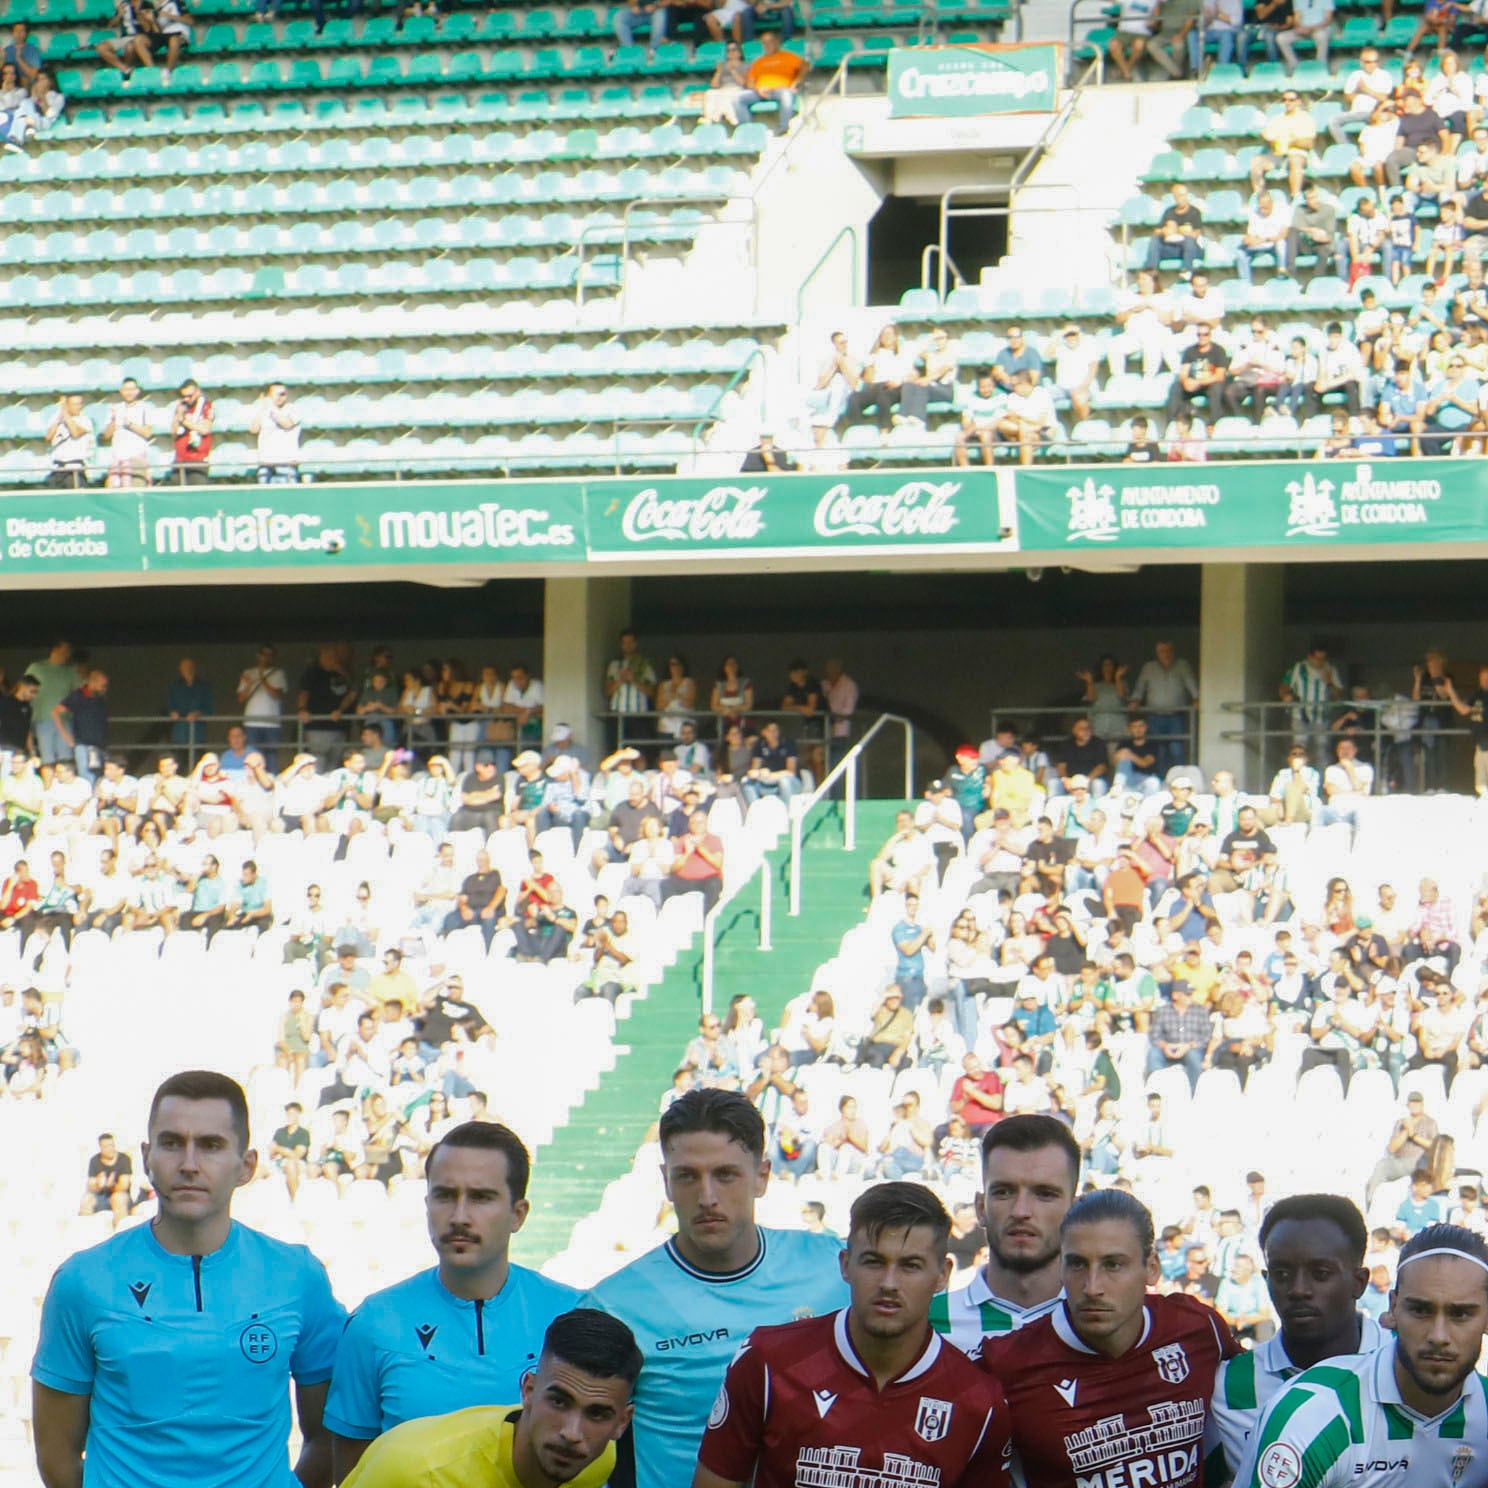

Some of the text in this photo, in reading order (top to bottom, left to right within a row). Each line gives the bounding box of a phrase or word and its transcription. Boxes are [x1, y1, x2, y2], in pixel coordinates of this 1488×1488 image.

[1121, 485, 1219, 506] AYUNTAMIENTO
[1341, 480, 1441, 502] AYUNTAMIENTO
[8, 540, 31, 558] de
[656, 1328, 729, 1351] GIVOVA
